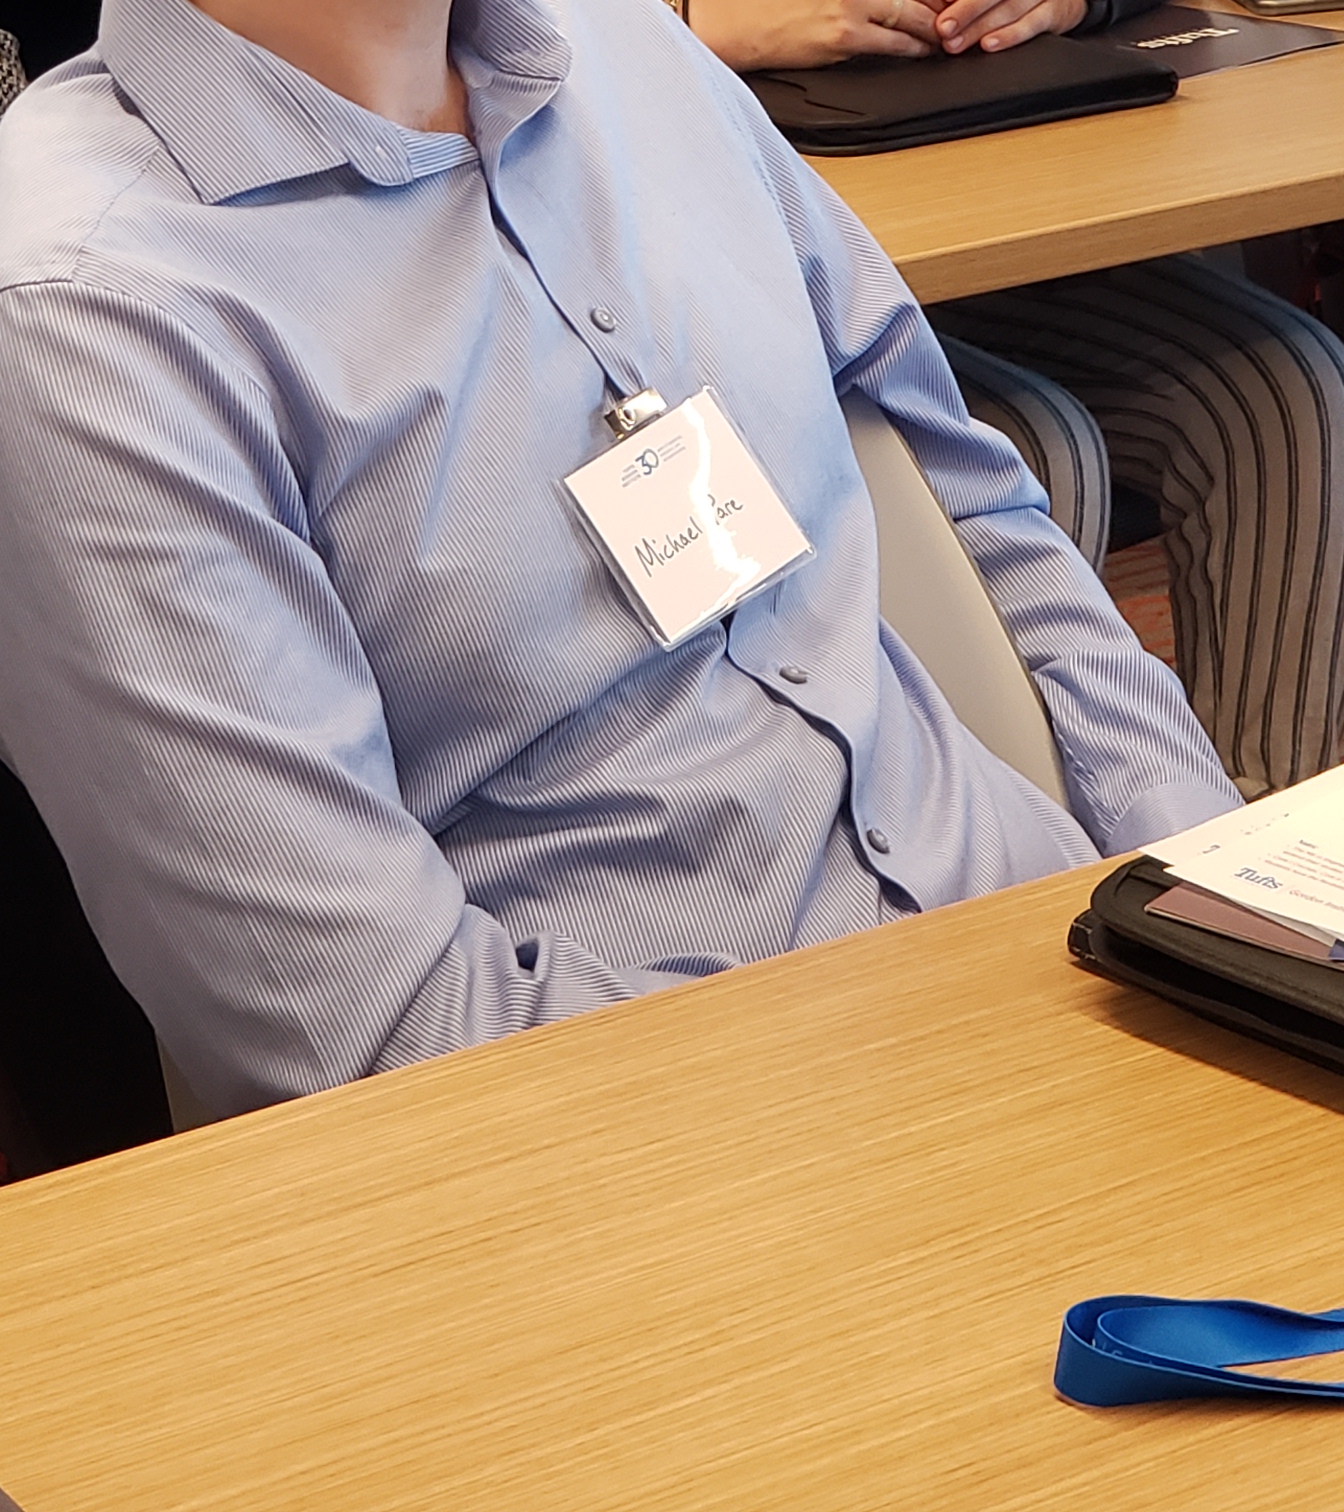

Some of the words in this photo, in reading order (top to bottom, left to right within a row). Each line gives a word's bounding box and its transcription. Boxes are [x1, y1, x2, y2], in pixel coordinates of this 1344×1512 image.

[634, 447, 660, 476] 30
[634, 515, 704, 577] Michael
[1234, 867, 1283, 889] Tufts
